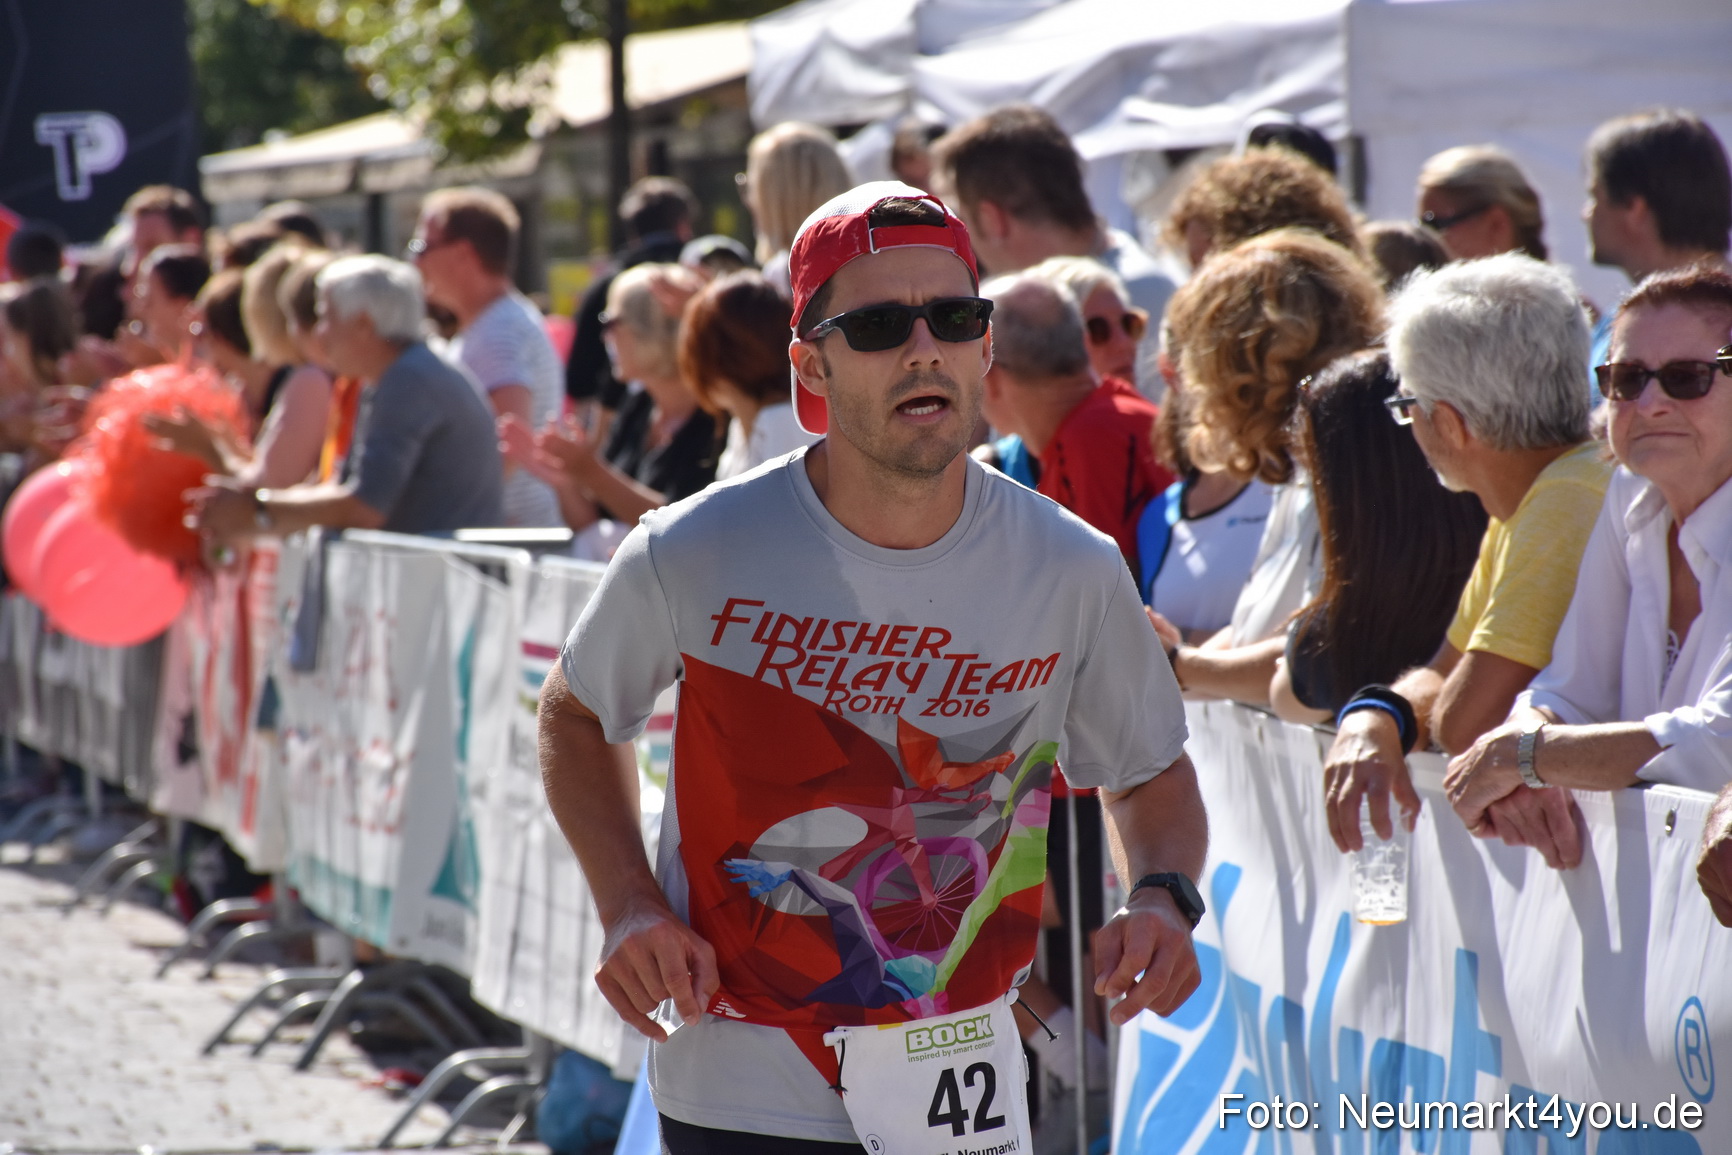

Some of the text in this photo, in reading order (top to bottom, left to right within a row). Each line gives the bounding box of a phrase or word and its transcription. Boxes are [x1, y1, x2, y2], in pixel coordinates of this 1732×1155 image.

[710, 597, 952, 659] FINISHER
[753, 639, 1061, 700] RELAY TEAM
[822, 688, 991, 717] ROTH 2016
[906, 1013, 994, 1054] BOCK
[908, 1051, 940, 1063] inspired
[942, 1049, 952, 1058] by
[953, 1044, 973, 1055] smart
[927, 1062, 1006, 1137] 42
[870, 1139, 880, 1151] D
